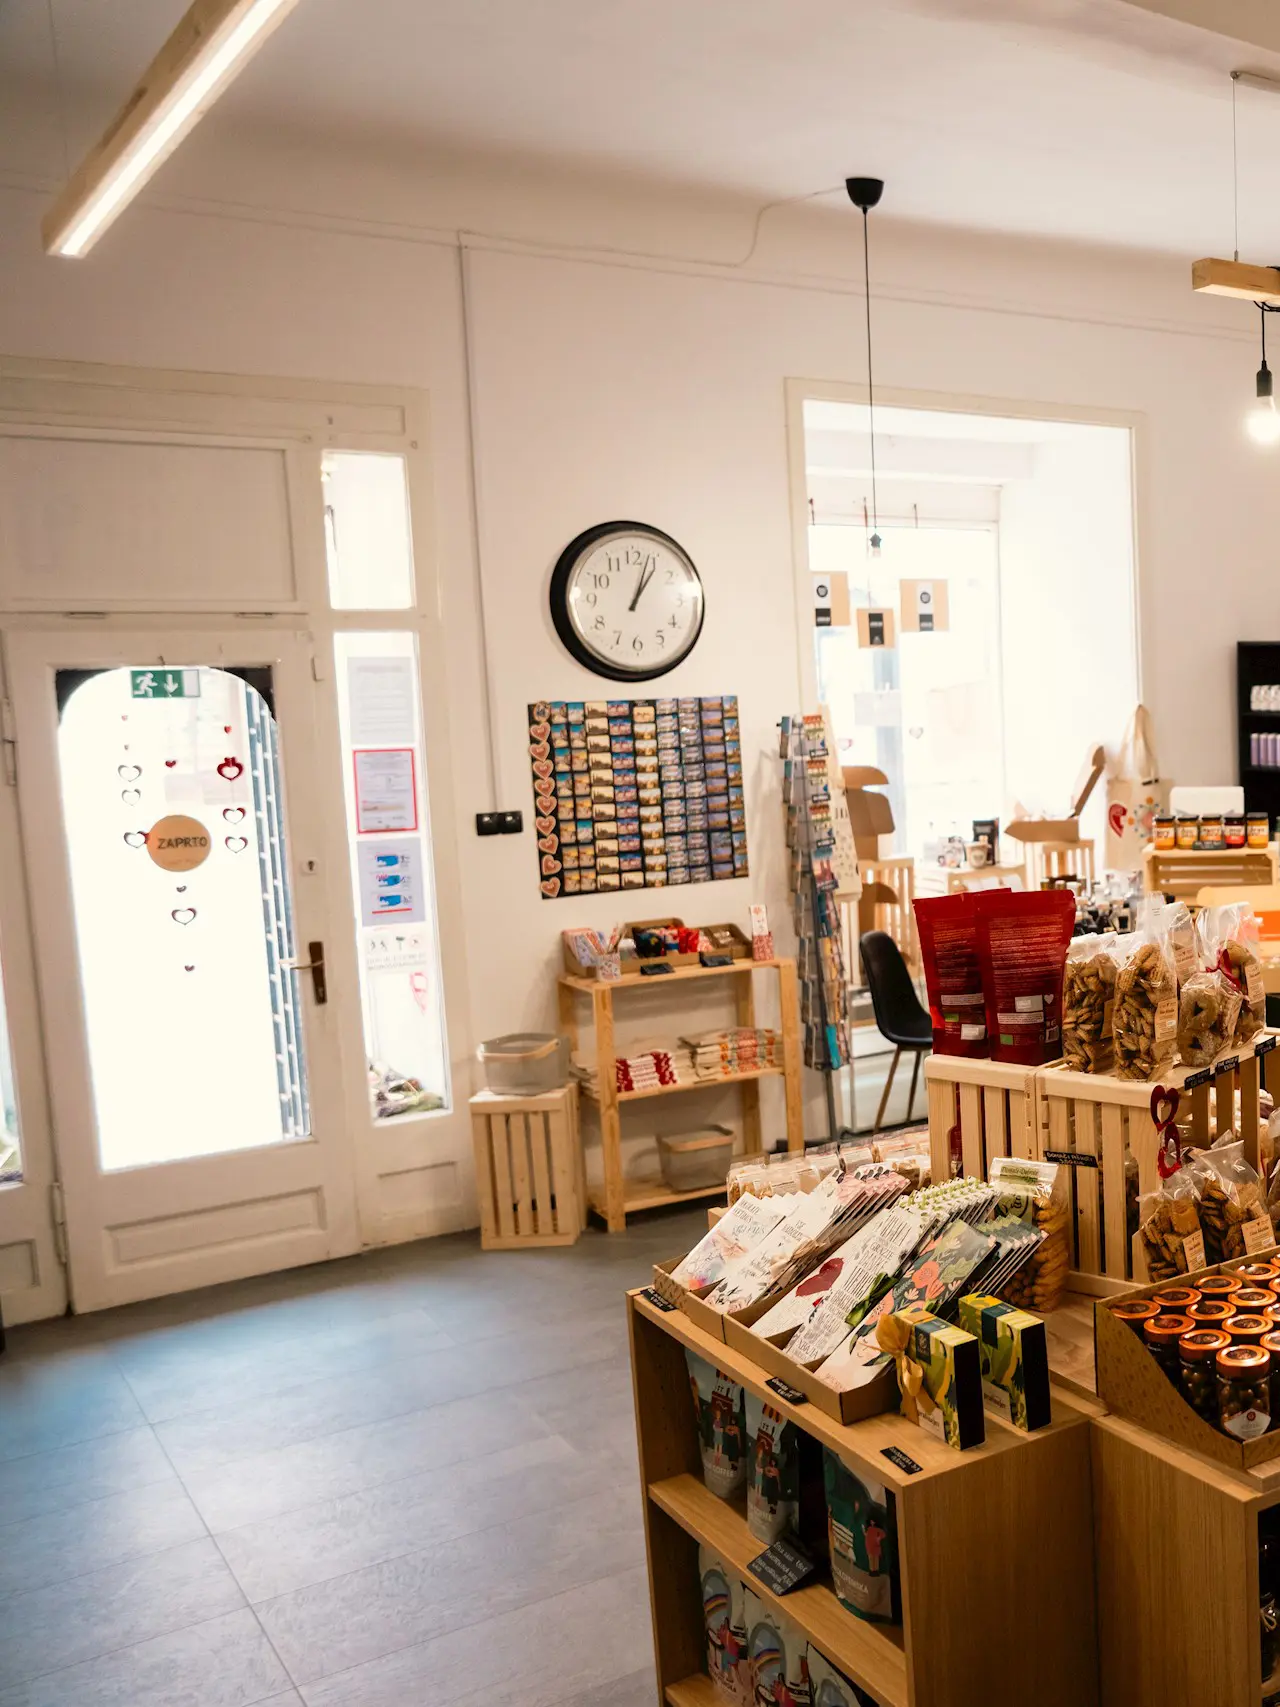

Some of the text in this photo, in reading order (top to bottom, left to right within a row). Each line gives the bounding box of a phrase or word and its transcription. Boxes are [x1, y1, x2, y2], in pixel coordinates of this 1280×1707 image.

[608, 557, 621, 572] 11
[625, 551, 643, 565] 12
[593, 574, 610, 589] 10
[665, 570, 674, 584] 2
[586, 593, 597, 607] 9
[594, 616, 605, 630] 8
[668, 614, 677, 628] 4
[613, 631, 622, 645] 7
[632, 635, 643, 651] 6
[655, 630, 665, 645] 5
[157, 836, 208, 850] ZAPRTO
[869, 1240, 895, 1261] GRAZIE
